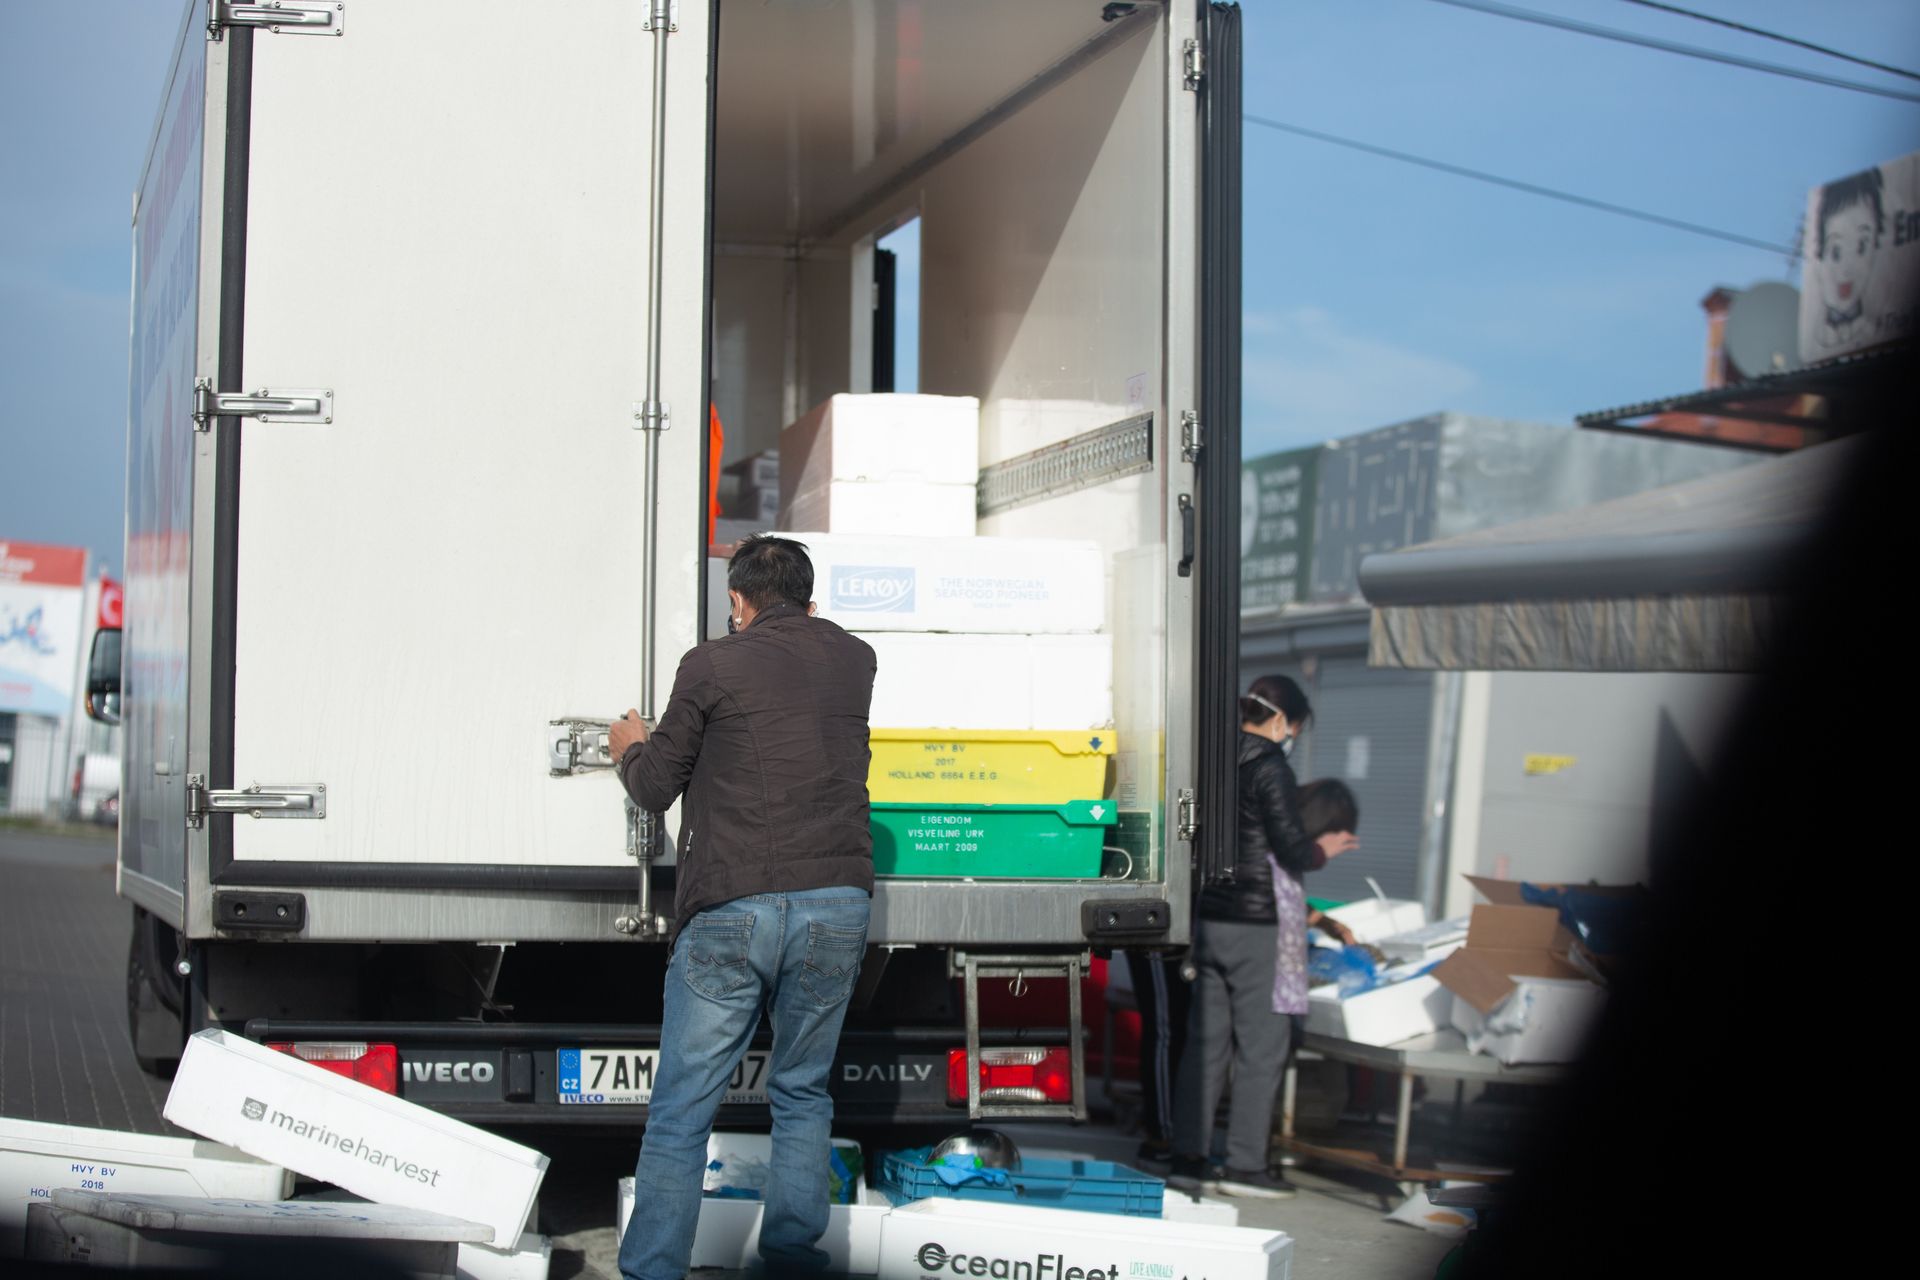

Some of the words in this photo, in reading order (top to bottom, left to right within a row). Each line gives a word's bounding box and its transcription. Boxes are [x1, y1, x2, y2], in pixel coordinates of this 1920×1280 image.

[837, 576, 912, 600] LERØY
[940, 577, 963, 588] THE
[966, 578, 1045, 589] NORWEGIAN
[935, 588, 993, 599] SEAFOOD
[997, 589, 1050, 601] PIONEER
[924, 743, 945, 752] HVY
[952, 743, 966, 752] BV
[935, 758, 956, 766] 2017
[888, 770, 935, 780] HOLLAND
[921, 815, 972, 825] EIGENDOM
[908, 829, 961, 838] VISVEILING
[965, 829, 984, 838] URK
[915, 843, 950, 852] MAART
[955, 843, 978, 852] 2009
[402, 1062, 494, 1082] IVECO
[590, 1056, 653, 1090] 7AM
[843, 1064, 933, 1081] DAILY
[562, 1079, 578, 1090] CZ
[564, 1094, 604, 1103] IVECO
[270, 1110, 441, 1188] marineharvest
[71, 1163, 95, 1175] HVY
[101, 1167, 116, 1177] BV
[81, 1179, 104, 1190] 2018
[30, 1187, 51, 1198] HOL
[914, 1242, 1119, 1280] OceanFleet
